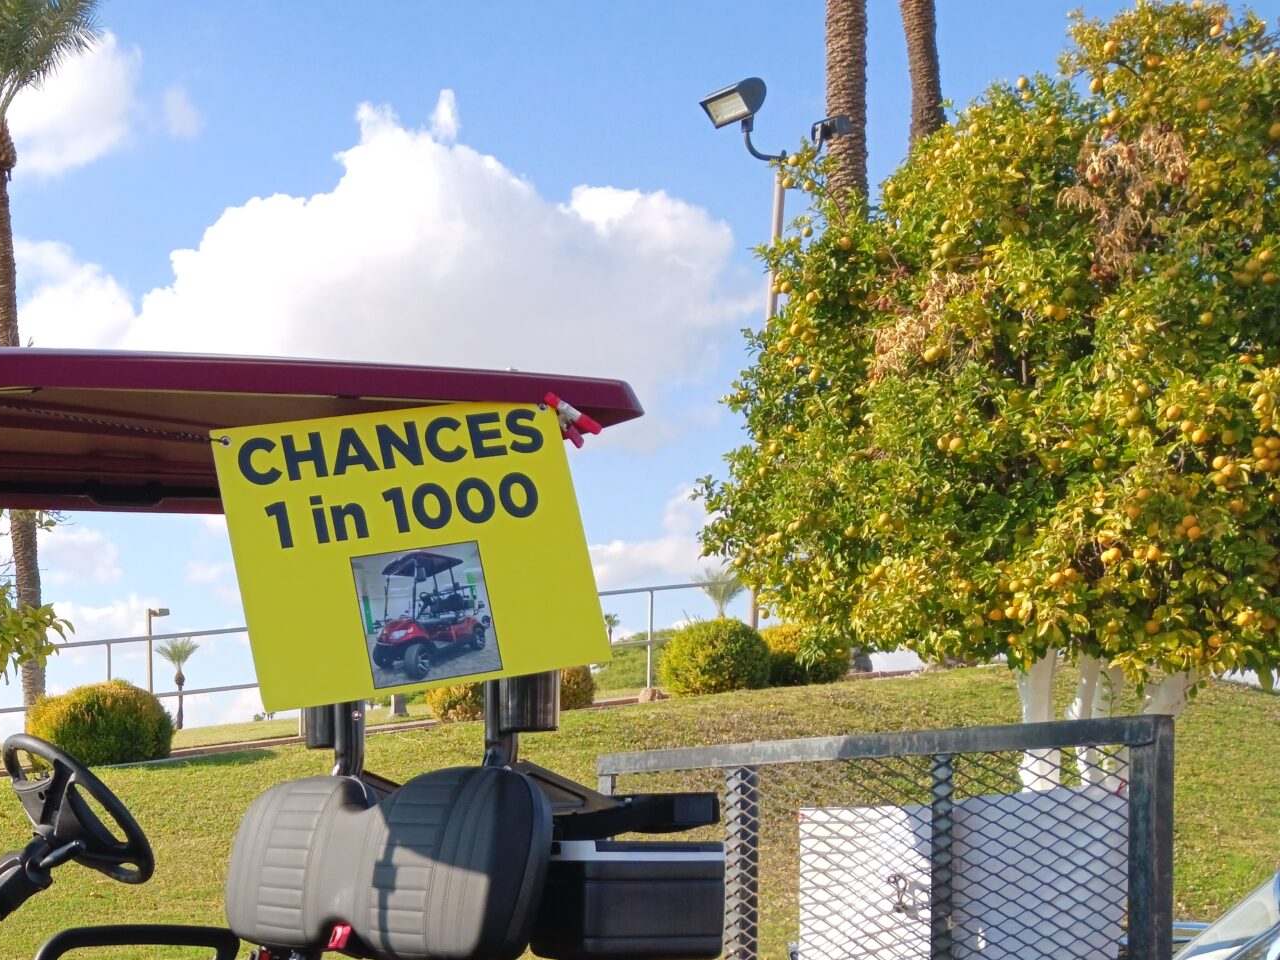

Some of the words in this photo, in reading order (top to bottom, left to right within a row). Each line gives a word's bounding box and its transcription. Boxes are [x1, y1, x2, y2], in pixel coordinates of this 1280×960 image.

[236, 408, 545, 486] CHANCES
[264, 501, 294, 549] 1
[309, 496, 370, 544] in
[381, 472, 539, 534] 1000
